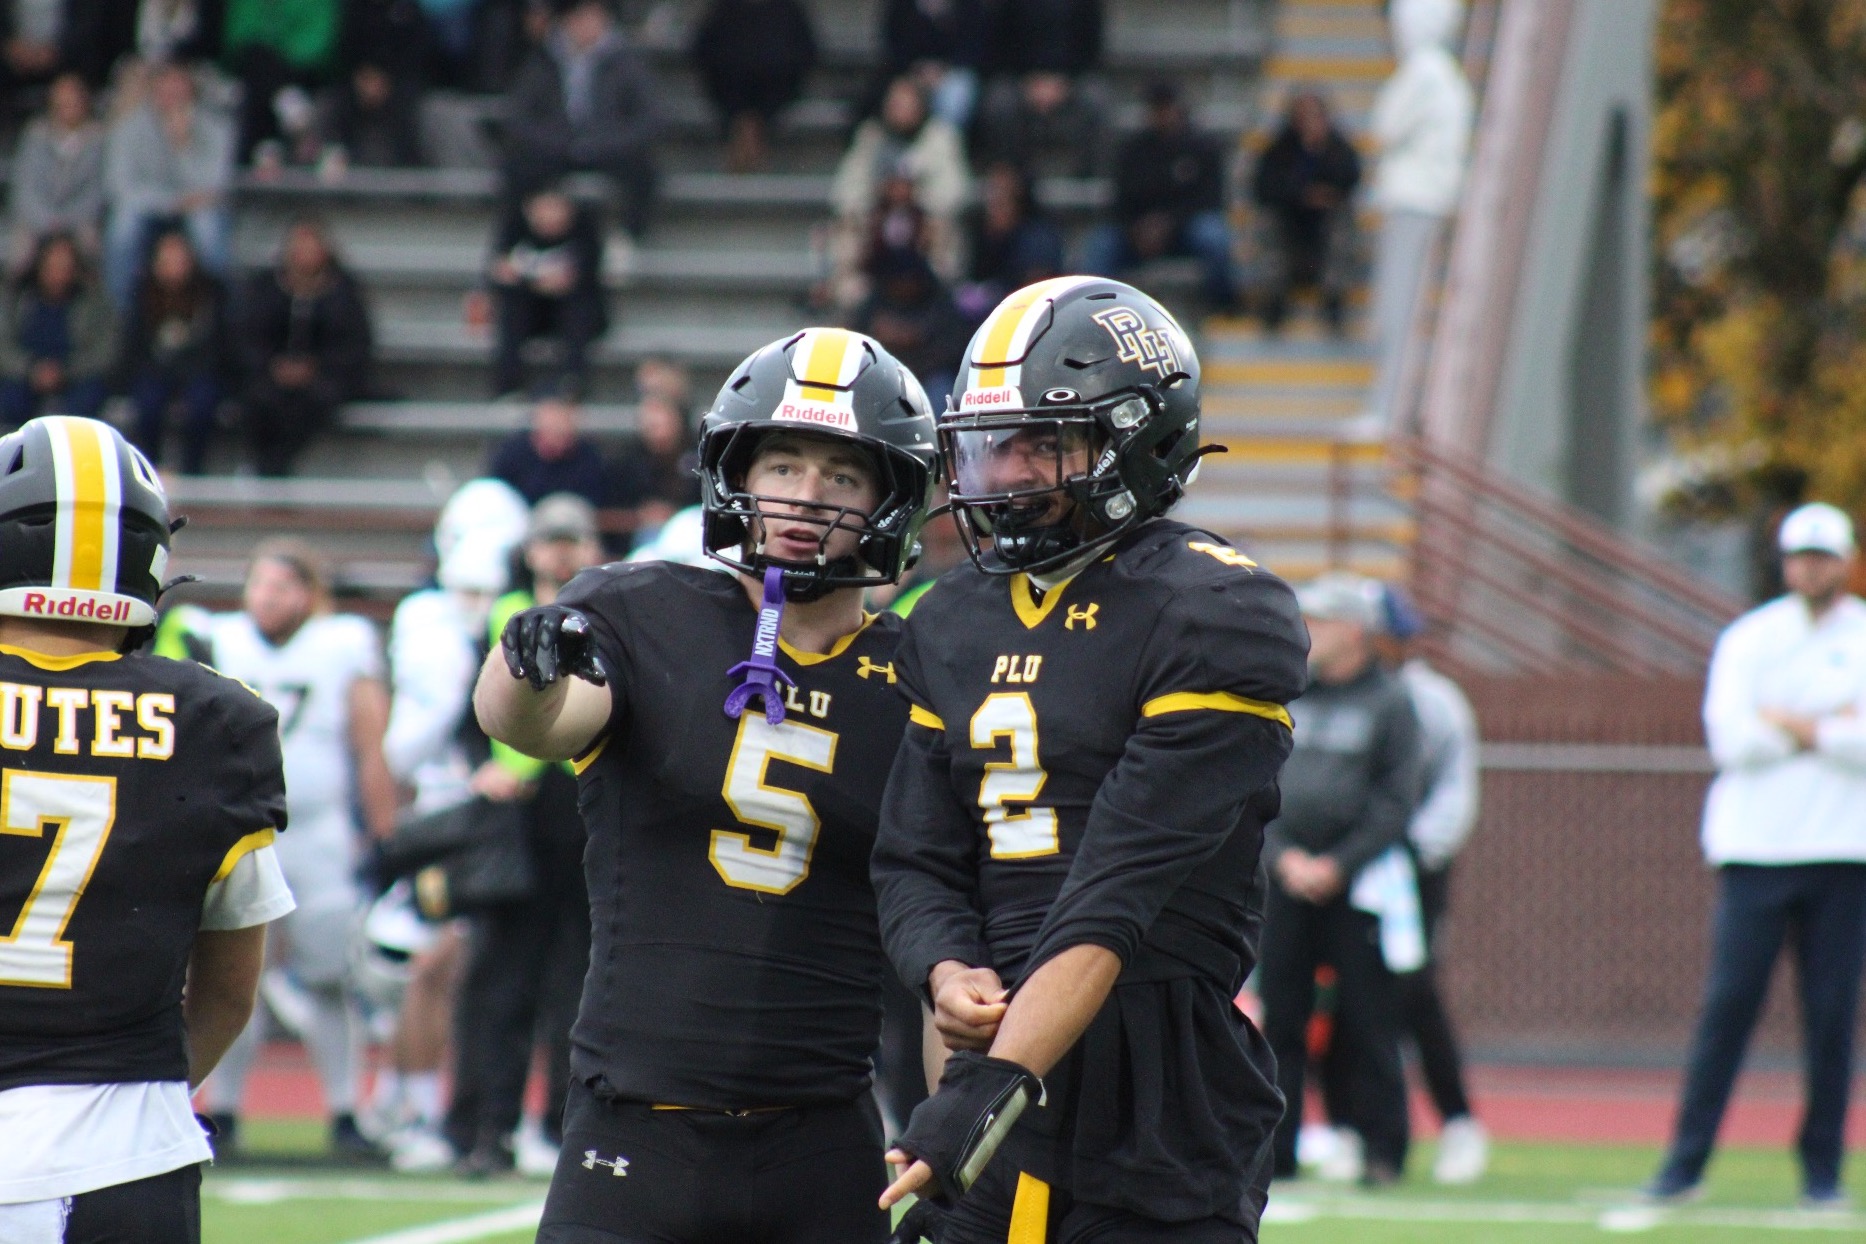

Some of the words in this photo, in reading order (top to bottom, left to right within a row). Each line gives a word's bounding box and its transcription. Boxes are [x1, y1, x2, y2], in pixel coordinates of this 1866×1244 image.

[782, 404, 851, 427] Riddell
[965, 390, 1011, 406] Riddell
[23, 592, 131, 621] Riddell
[754, 608, 779, 657] NXTRND
[990, 655, 1043, 683] PLU
[0, 681, 175, 761] UTES
[969, 692, 1060, 859] 2
[708, 709, 839, 896] 5
[0, 768, 117, 989] 7
